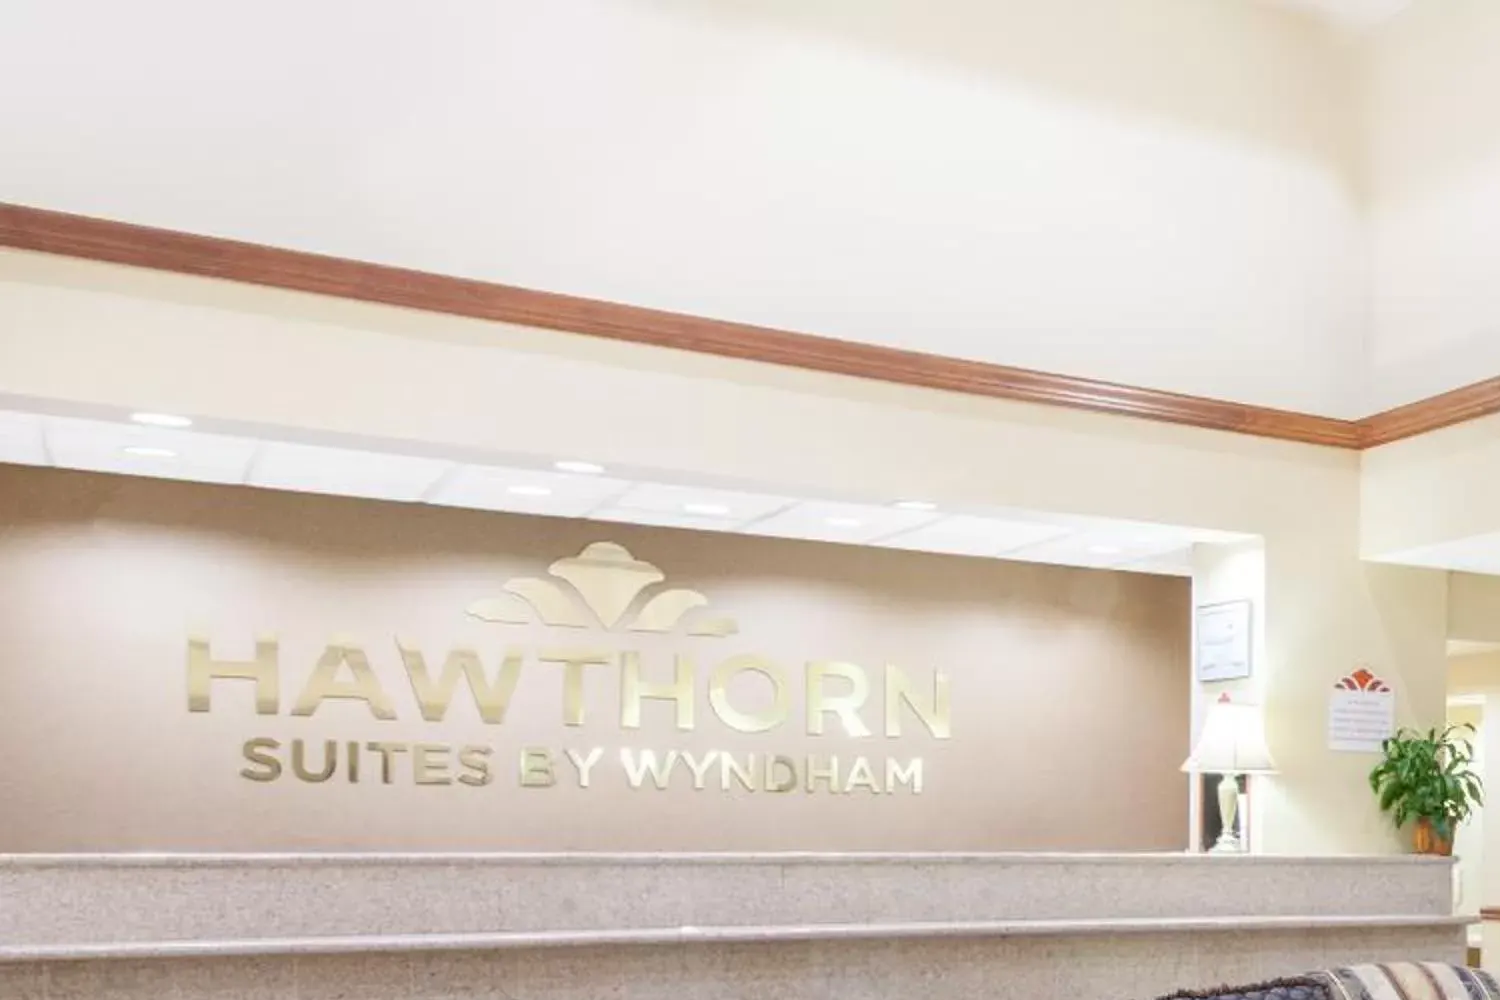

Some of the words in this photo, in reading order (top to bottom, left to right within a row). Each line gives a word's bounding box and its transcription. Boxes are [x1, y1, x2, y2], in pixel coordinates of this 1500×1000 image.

[187, 637, 952, 738] HAWTHORN
[241, 737, 494, 786] SUITES
[520, 746, 604, 788] BY
[620, 748, 925, 794] WYNDHAM
